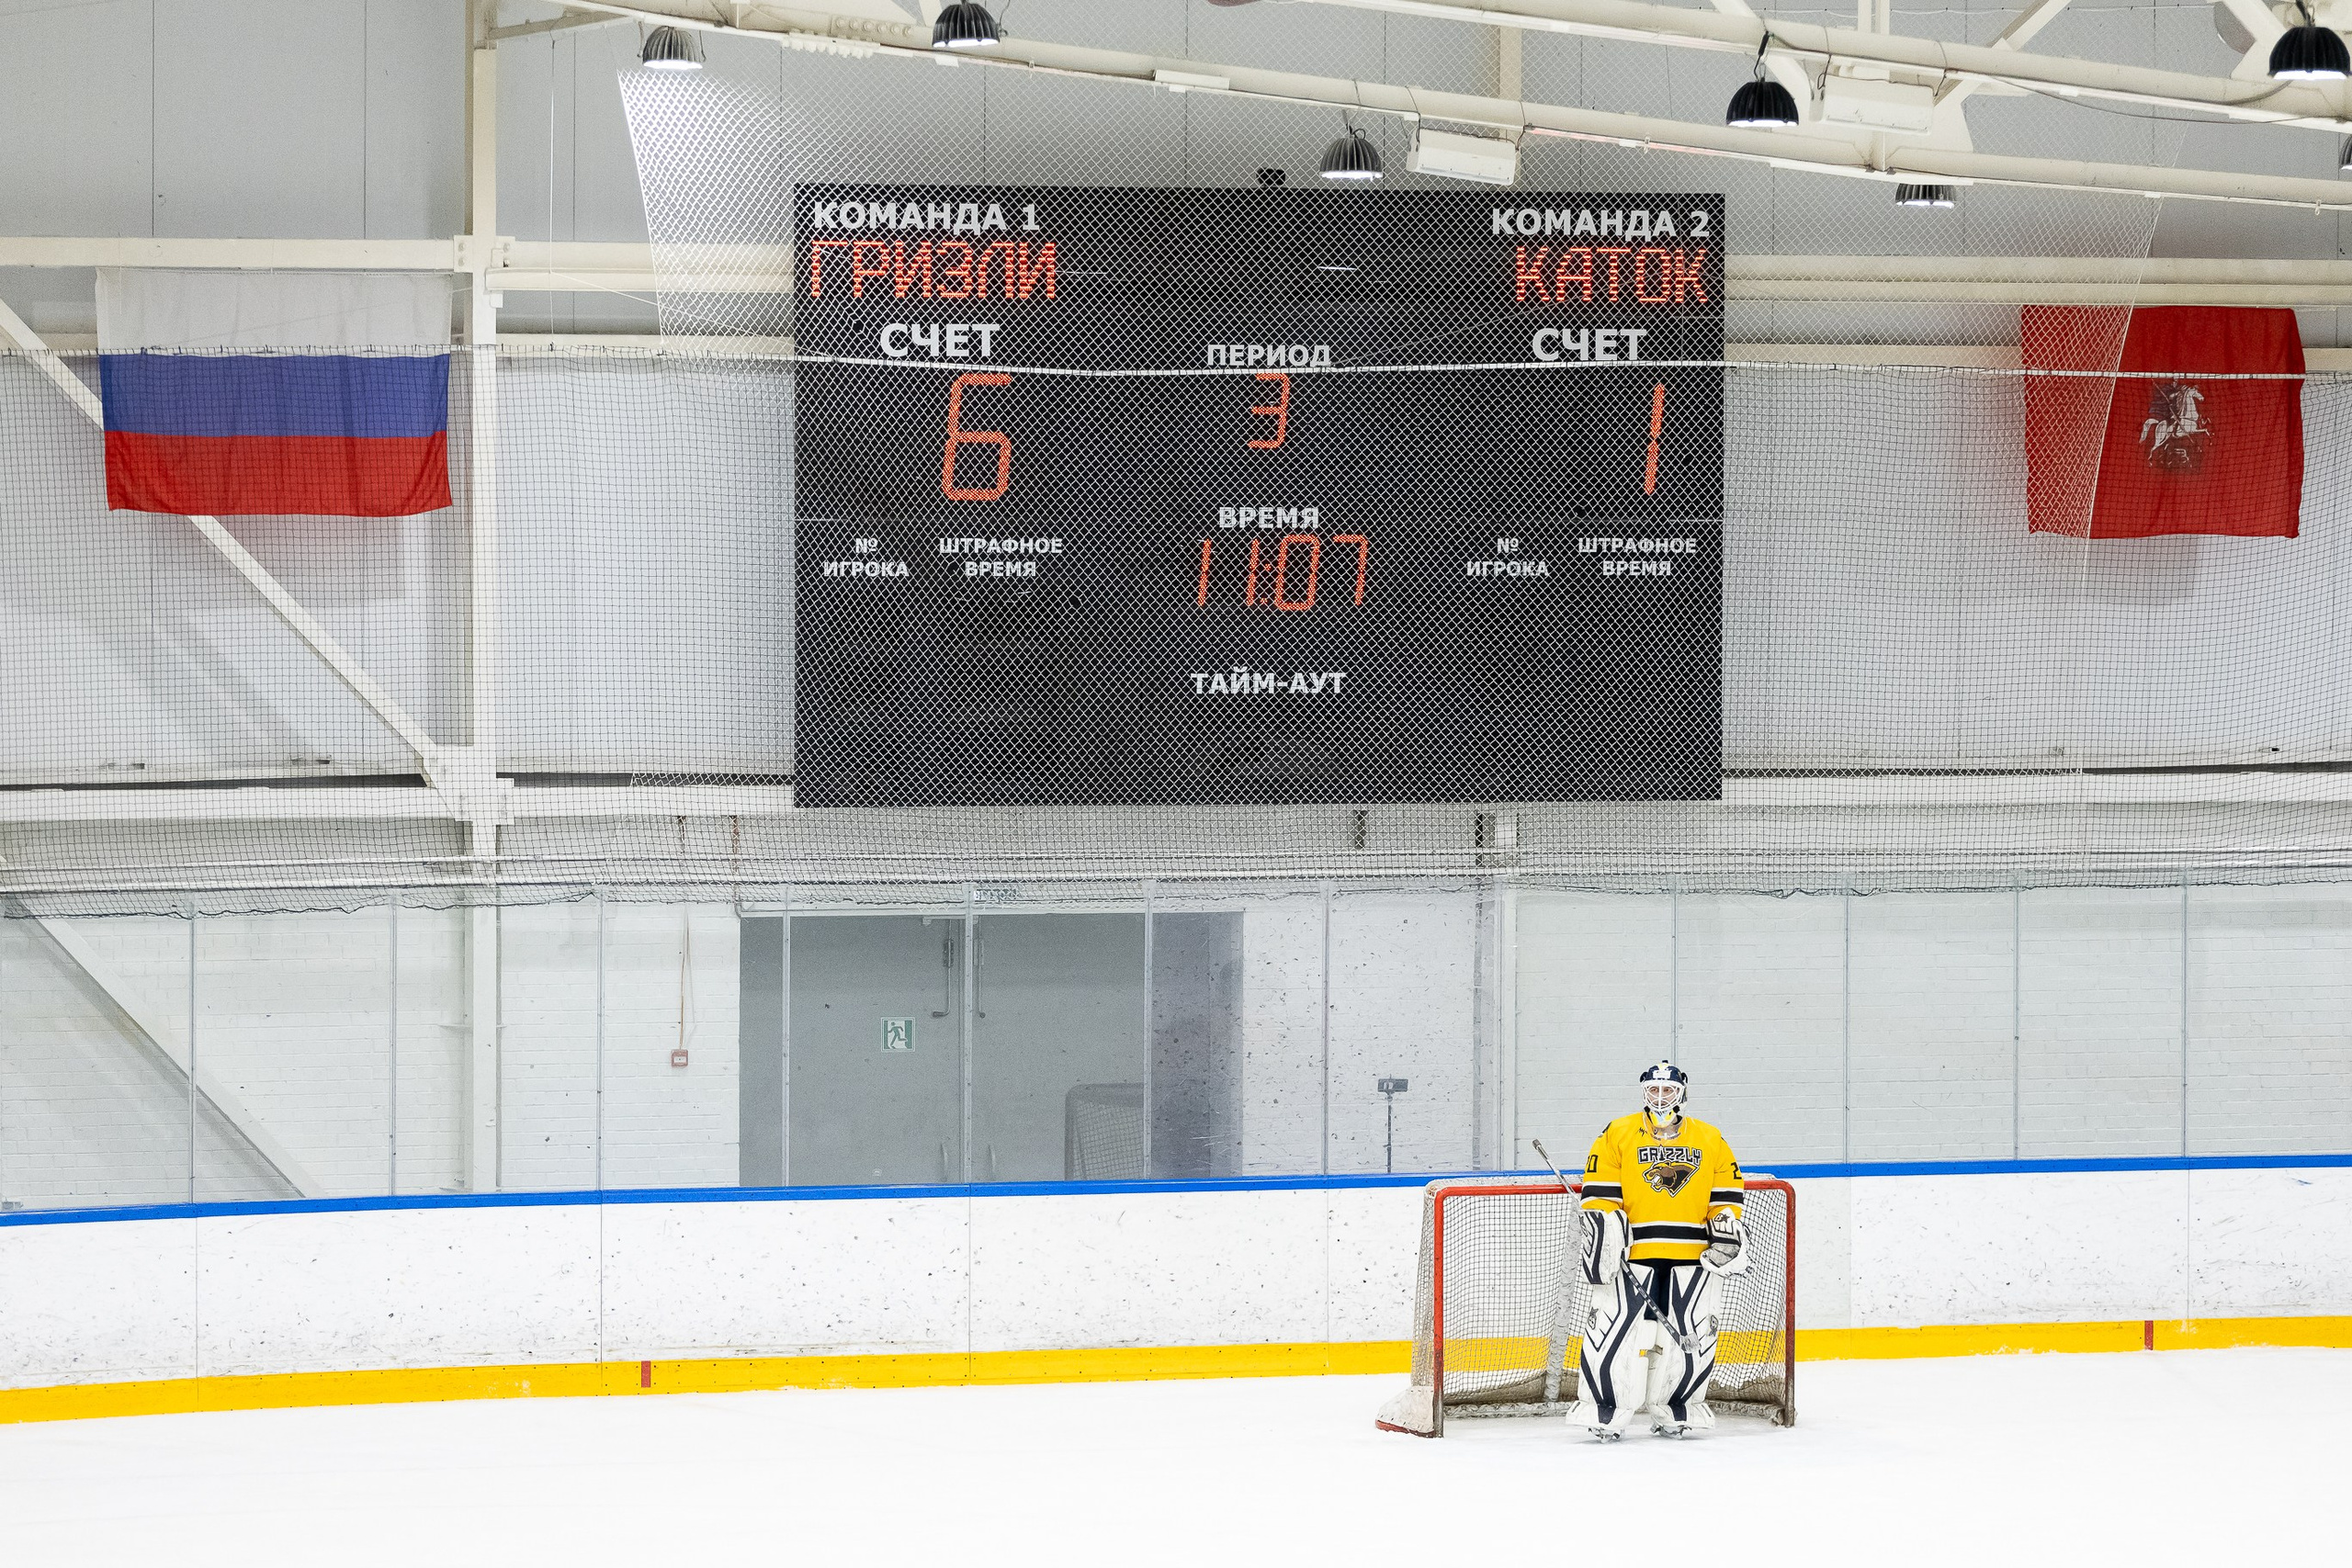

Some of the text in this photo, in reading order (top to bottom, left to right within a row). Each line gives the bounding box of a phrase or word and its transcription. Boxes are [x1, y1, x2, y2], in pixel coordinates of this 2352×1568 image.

[814, 201, 1040, 236] КОМАНДА 1
[1492, 209, 1710, 242] КОМАНДА 2
[1516, 245, 1708, 303] КАТОК
[879, 323, 1000, 358] СЧЕТ
[1532, 327, 1647, 361] СЧЕТ
[1207, 344, 1332, 368] ПЕРИОД
[1247, 372, 1290, 449] 3
[941, 373, 1012, 501] 6
[1644, 382, 1665, 496] 1
[1218, 506, 1319, 528] ВРЕМЯ
[939, 536, 1063, 554] ШТРАФНОЕ
[1578, 536, 1697, 553] ШТРАФНОЕ
[823, 561, 910, 577] ИГРОКА
[965, 561, 1036, 577] ВРЕМЯ
[1197, 534, 1369, 611] 11:07
[1466, 560, 1549, 576] ИГРОКА
[1602, 560, 1671, 576] ВРЕМЯ
[1191, 666, 1347, 694] ТАЙМ-АУТ
[1638, 1145, 1702, 1165] GRIZZLY
